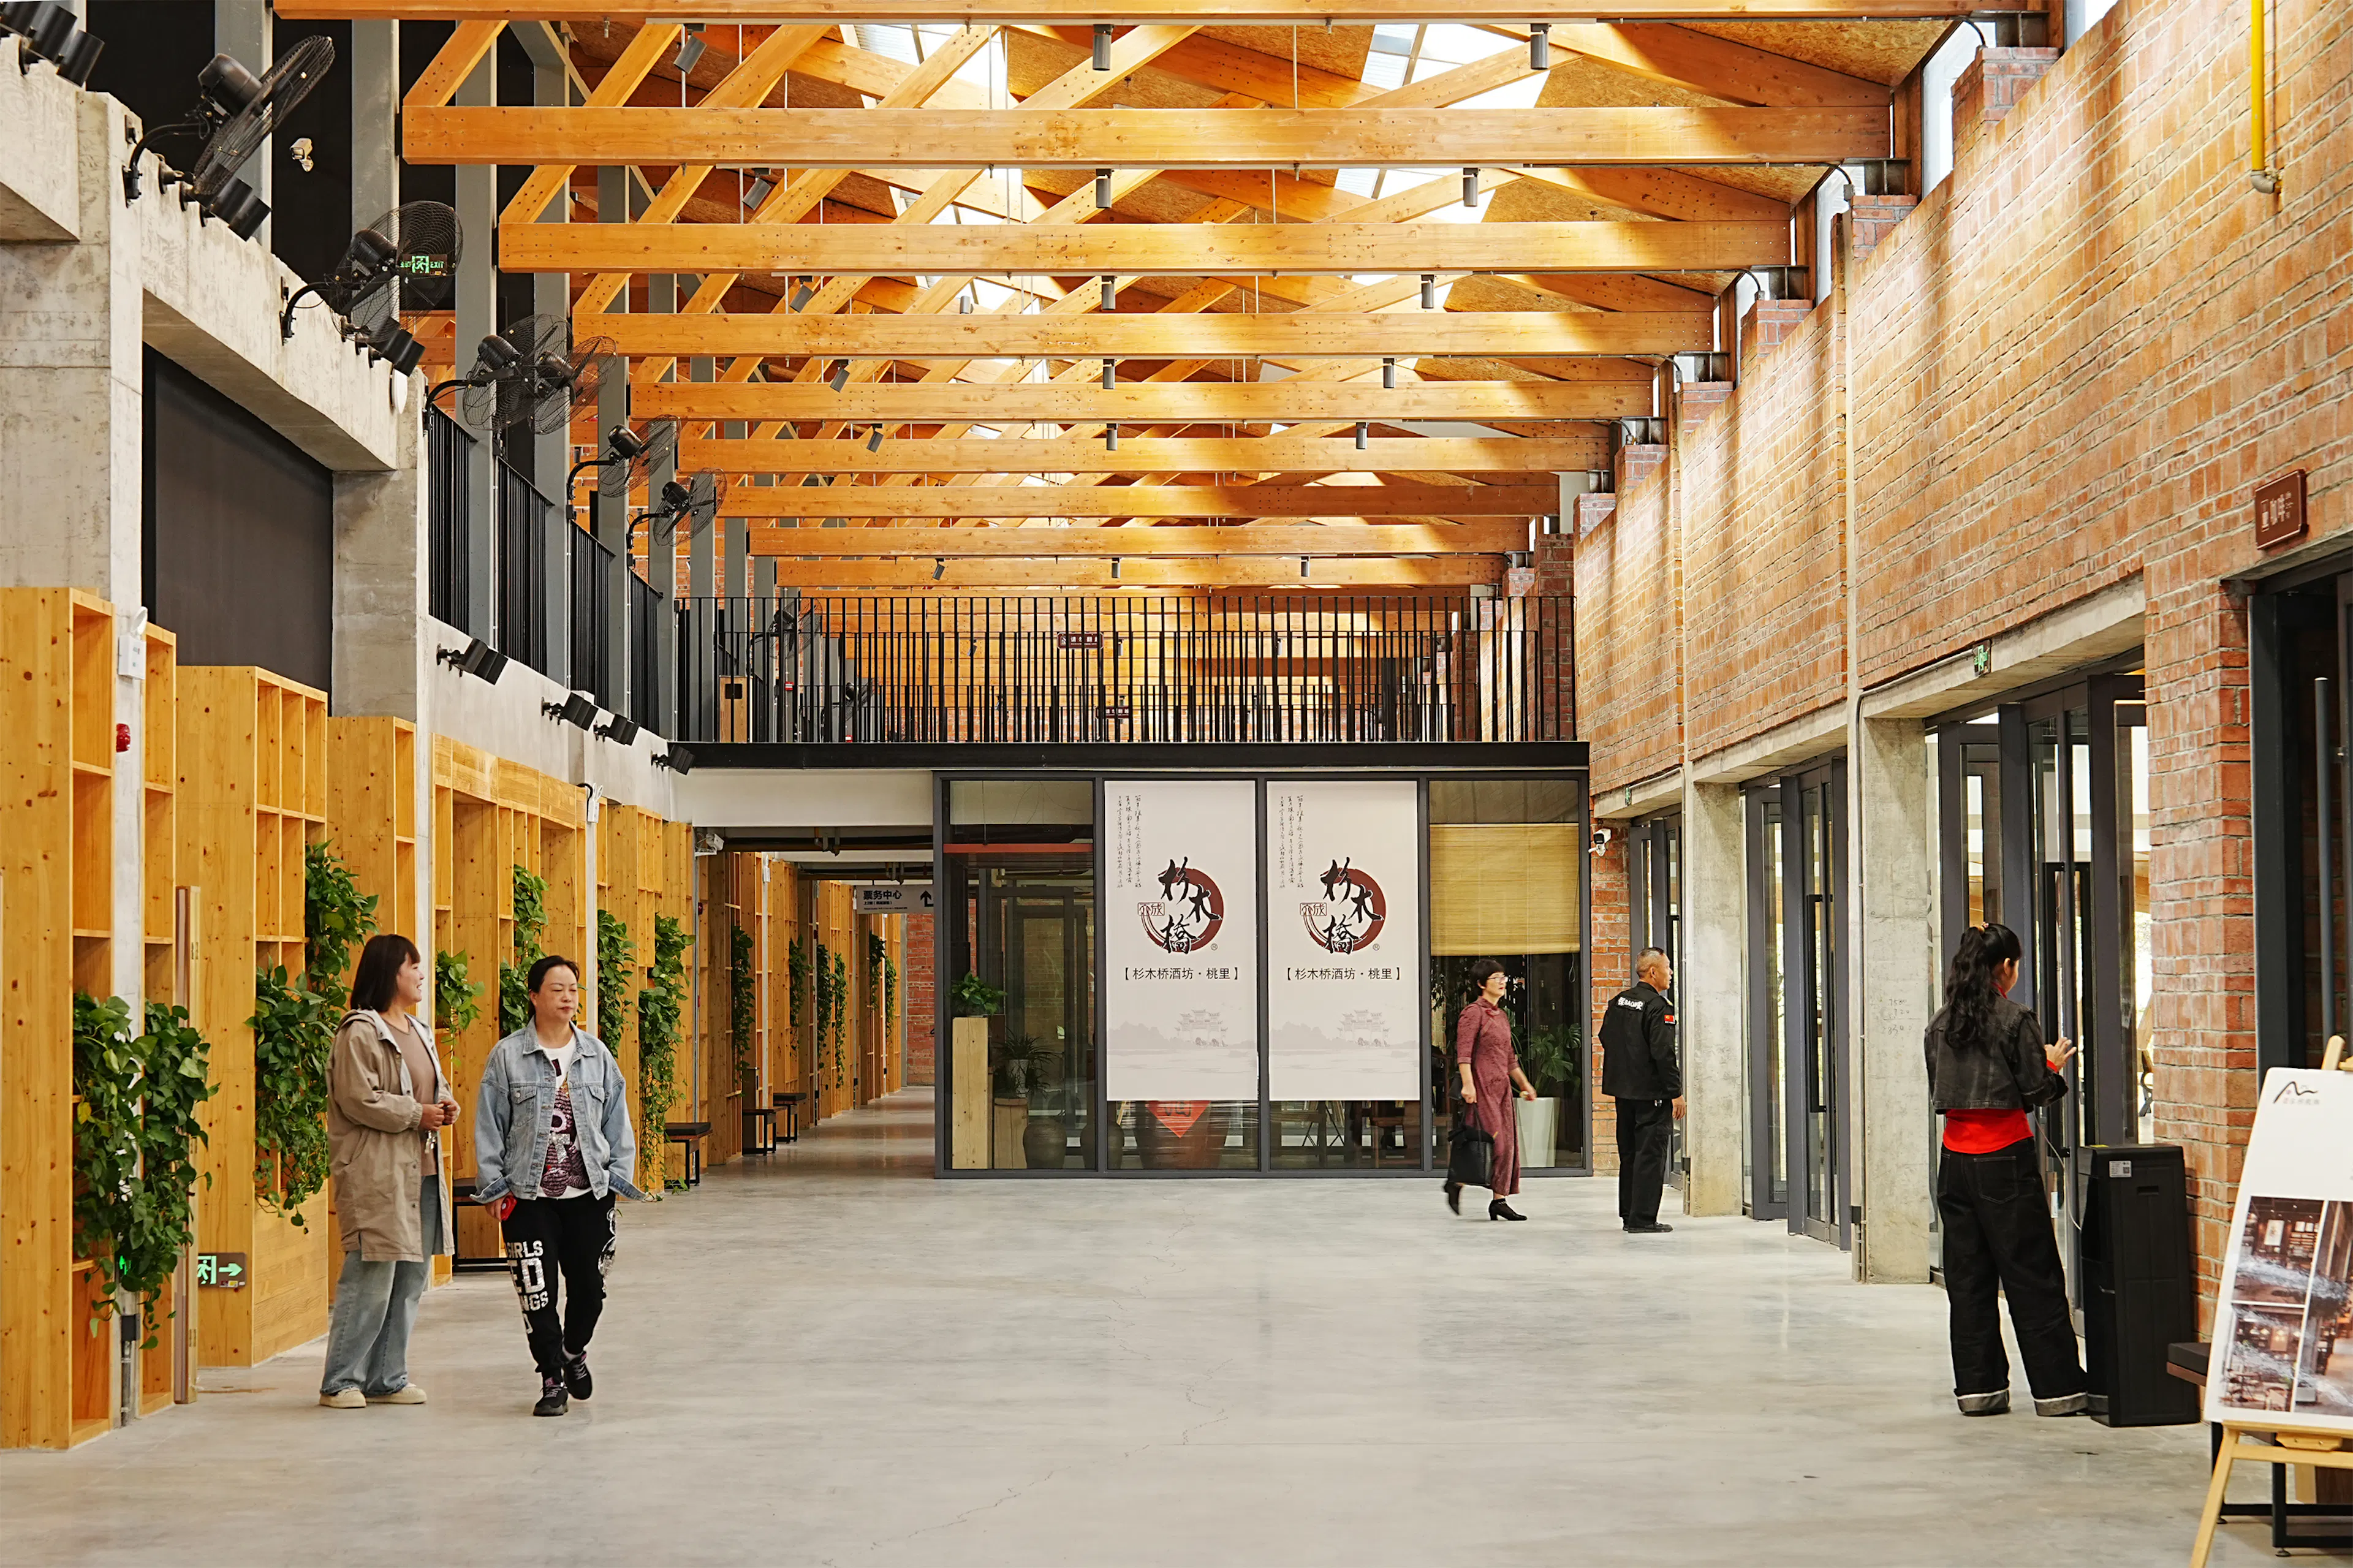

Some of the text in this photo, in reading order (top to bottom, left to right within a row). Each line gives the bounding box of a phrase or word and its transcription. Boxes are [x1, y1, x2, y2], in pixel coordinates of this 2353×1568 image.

[863, 890, 902, 900] 票务中心
[506, 1240, 544, 1258] GIRLS
